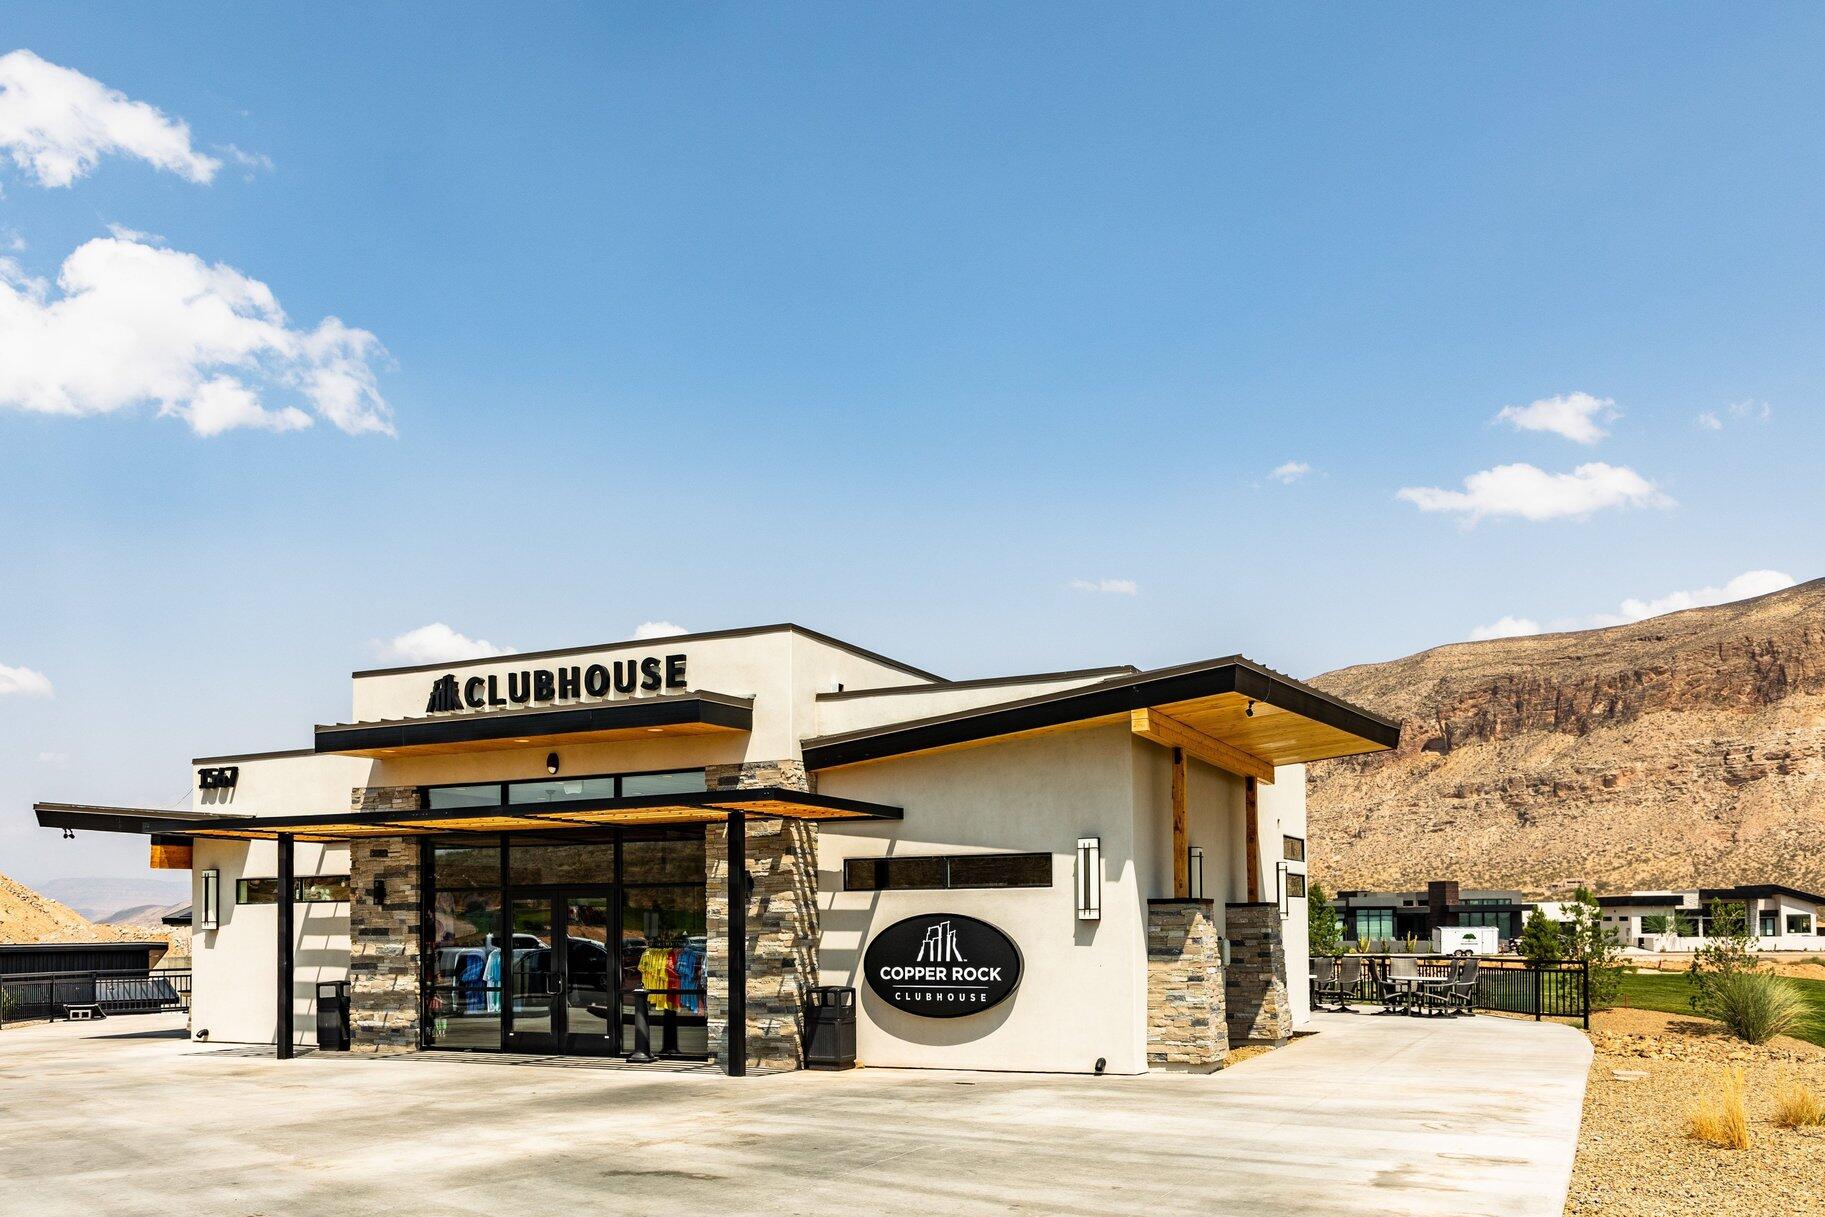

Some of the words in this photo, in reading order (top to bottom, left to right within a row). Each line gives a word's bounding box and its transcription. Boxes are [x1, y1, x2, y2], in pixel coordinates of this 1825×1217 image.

[464, 654, 687, 708] CLUBHOUSE
[880, 966, 947, 981] COPPER
[952, 967, 1001, 981] ROCK
[895, 992, 986, 1002] CLUBHOUSE
